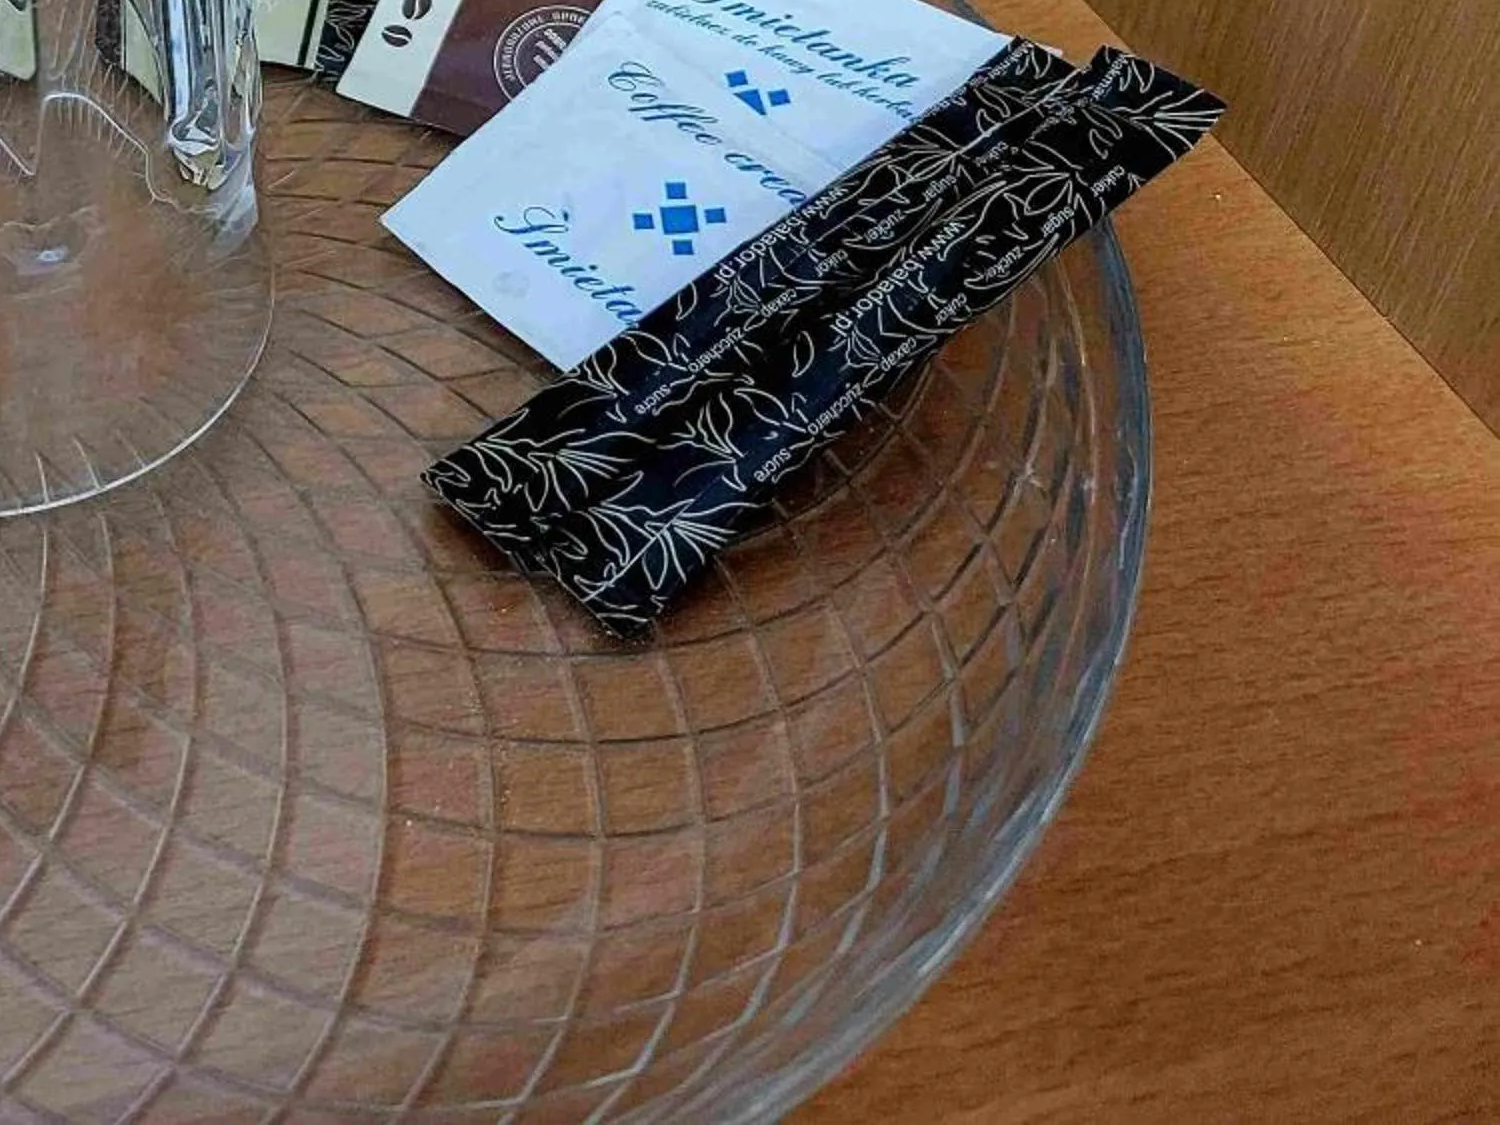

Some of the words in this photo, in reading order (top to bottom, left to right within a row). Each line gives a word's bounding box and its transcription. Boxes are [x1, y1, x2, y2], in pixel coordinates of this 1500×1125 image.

[732, 32, 757, 47] do
[758, 43, 816, 75] kawy
[608, 61, 722, 145] Coffee
[723, 153, 808, 205] crea
[920, 170, 957, 203] sugar
[1087, 162, 1129, 200] cukier
[710, 182, 847, 288] www.balador.pl
[862, 208, 907, 245] zucker
[1035, 201, 1076, 238] sugar
[493, 206, 643, 325] Śmieta
[812, 247, 850, 279] cukor
[826, 217, 966, 338] www.balador.pl
[932, 291, 970, 326] cukor
[686, 325, 747, 376] zucchero
[633, 382, 672, 416] sucre
[805, 382, 865, 437] zucchero
[752, 445, 792, 484] sucre
